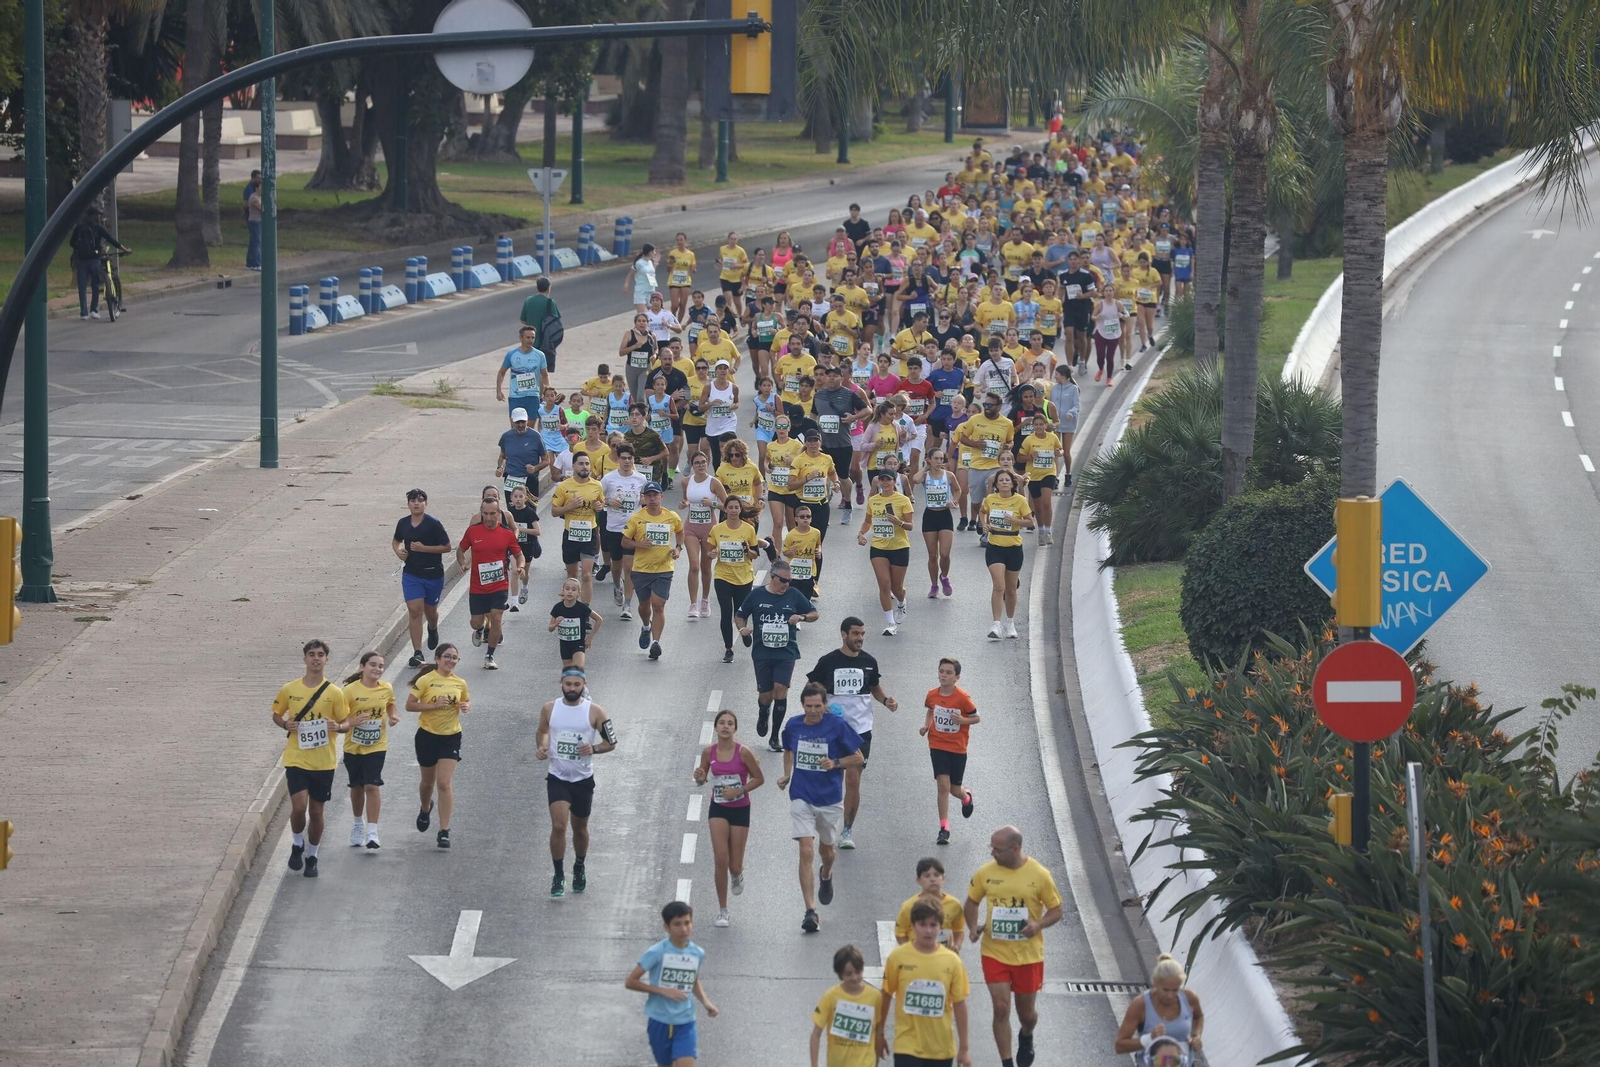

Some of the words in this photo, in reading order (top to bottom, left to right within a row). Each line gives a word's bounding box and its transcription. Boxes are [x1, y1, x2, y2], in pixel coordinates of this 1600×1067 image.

[570, 529, 590, 537] 20902
[481, 569, 503, 580] 23619
[763, 633, 787, 642] 24734
[836, 679, 862, 687] 10181
[300, 729, 326, 742] 8510
[354, 729, 380, 740] 22920
[798, 753, 826, 764] 2362
[993, 921, 1018, 933] 2191
[663, 969, 695, 983] 23628
[906, 994, 943, 1008] 21688
[834, 1016, 869, 1033] 21797
